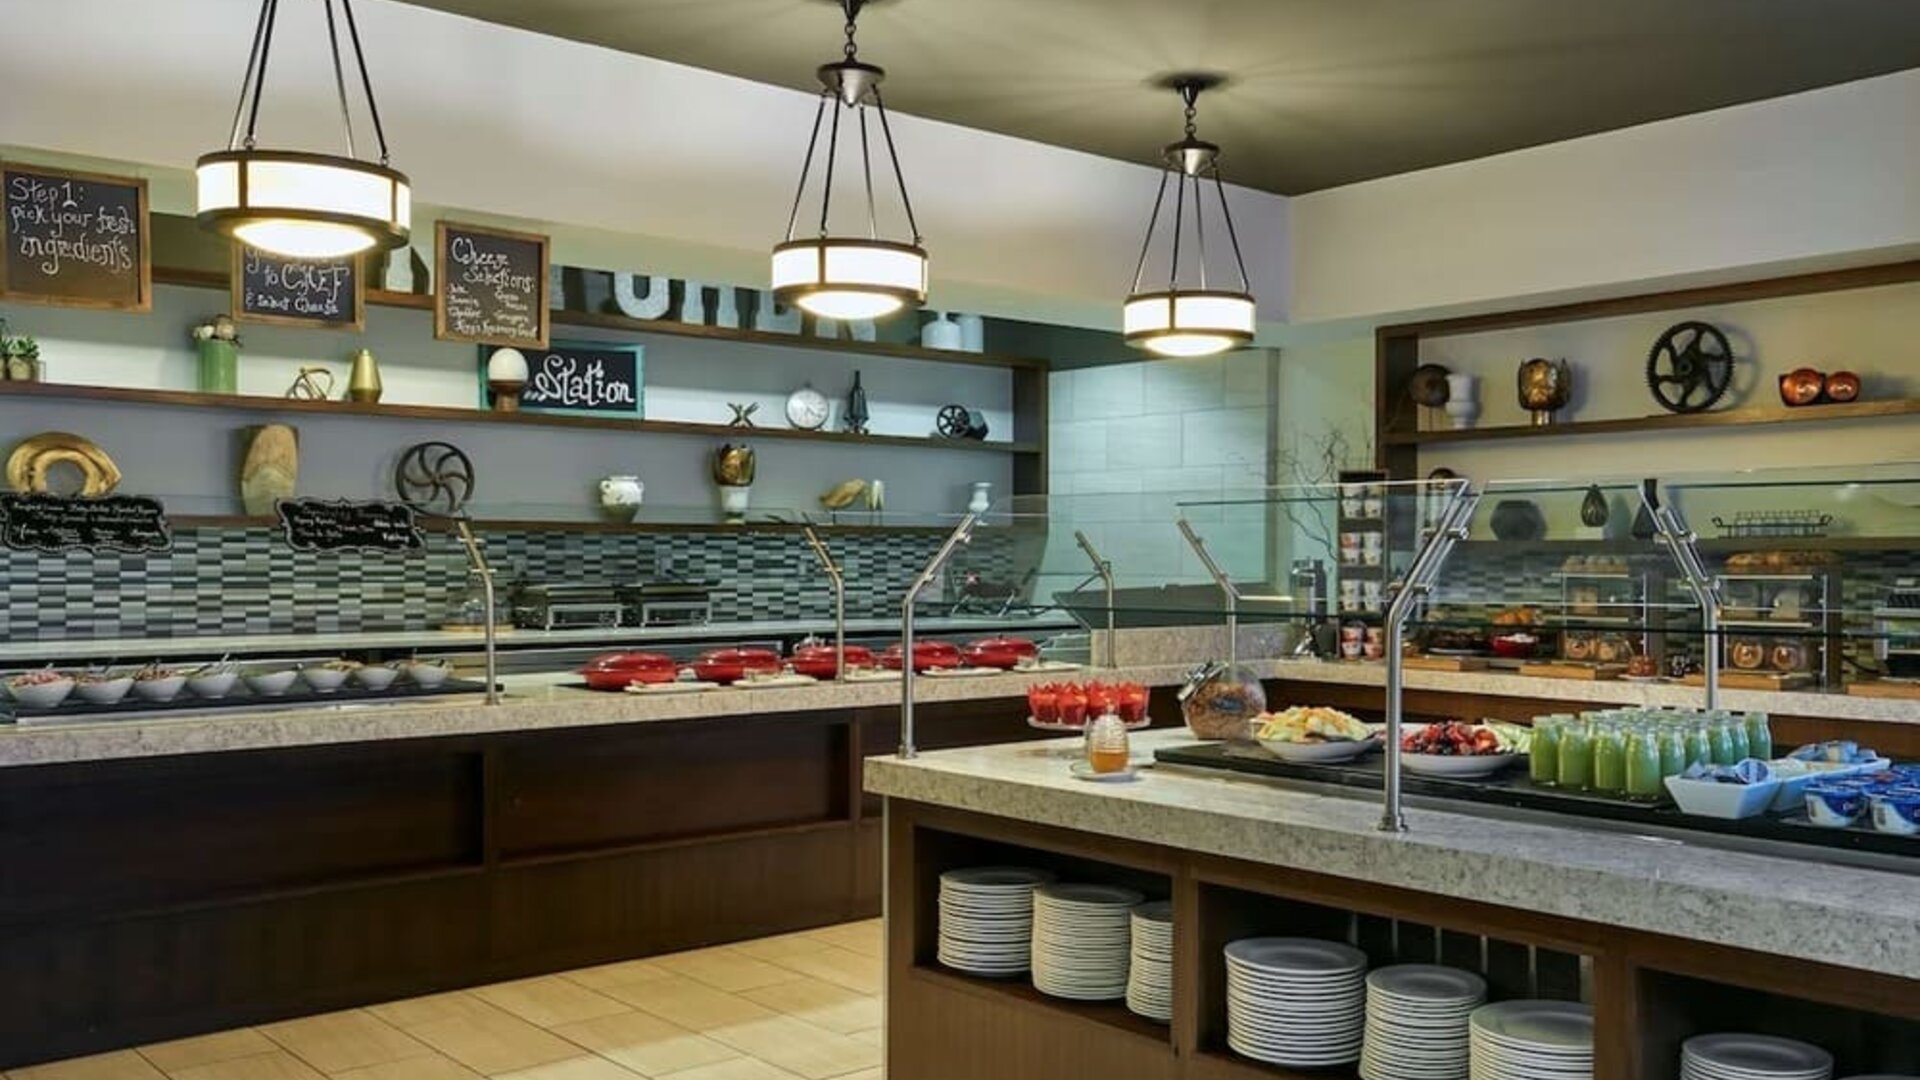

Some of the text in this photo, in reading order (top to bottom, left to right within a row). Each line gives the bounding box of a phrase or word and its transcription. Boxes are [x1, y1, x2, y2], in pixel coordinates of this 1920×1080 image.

[9, 177, 58, 210] Step
[10, 204, 48, 234] pick
[50, 212, 93, 238] your
[264, 264, 279, 287] to
